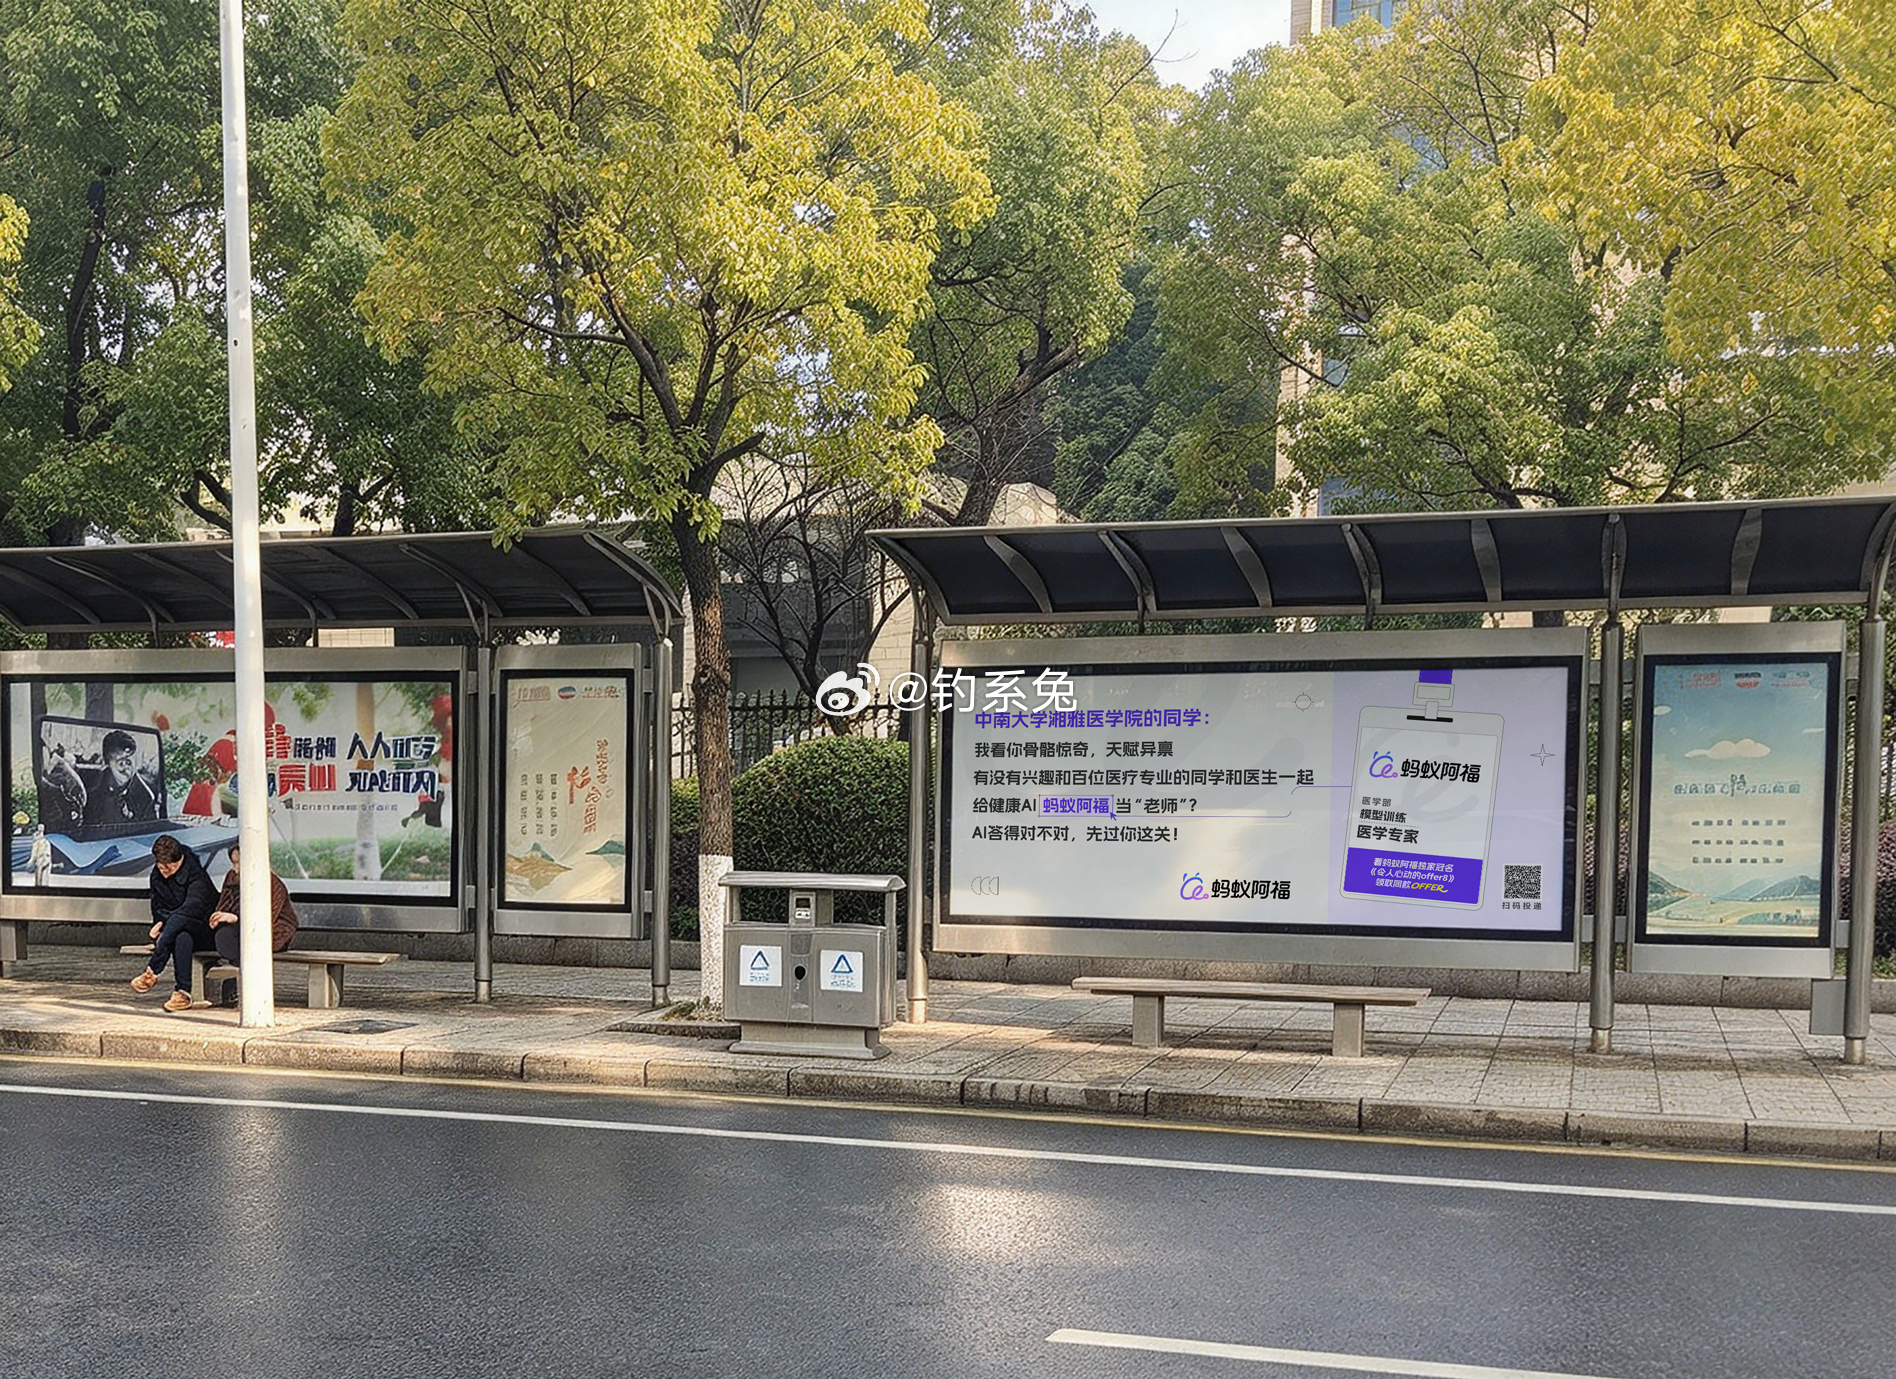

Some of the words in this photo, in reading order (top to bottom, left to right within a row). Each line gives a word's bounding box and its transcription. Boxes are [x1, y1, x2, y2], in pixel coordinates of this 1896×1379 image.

[974, 740, 1174, 759] 我看你骨骼惊奇，天赋异禀
[973, 768, 1314, 786] 有没有兴趣和百位医疗专业的同学和医生一起
[1400, 758, 1482, 783] 蚂蚁阿福
[972, 796, 1037, 813] 给健康AI
[1042, 797, 1110, 814] 蚂蚁阿福
[1361, 796, 1392, 807] 医学部
[1359, 808, 1407, 823] 模型训练
[971, 825, 1179, 843] AI答得对不对，先过你这关！
[1356, 824, 1419, 844] 医学专家
[1210, 879, 1292, 901] 蚂蚁阿福
[1501, 901, 1542, 910] 扫码投递
